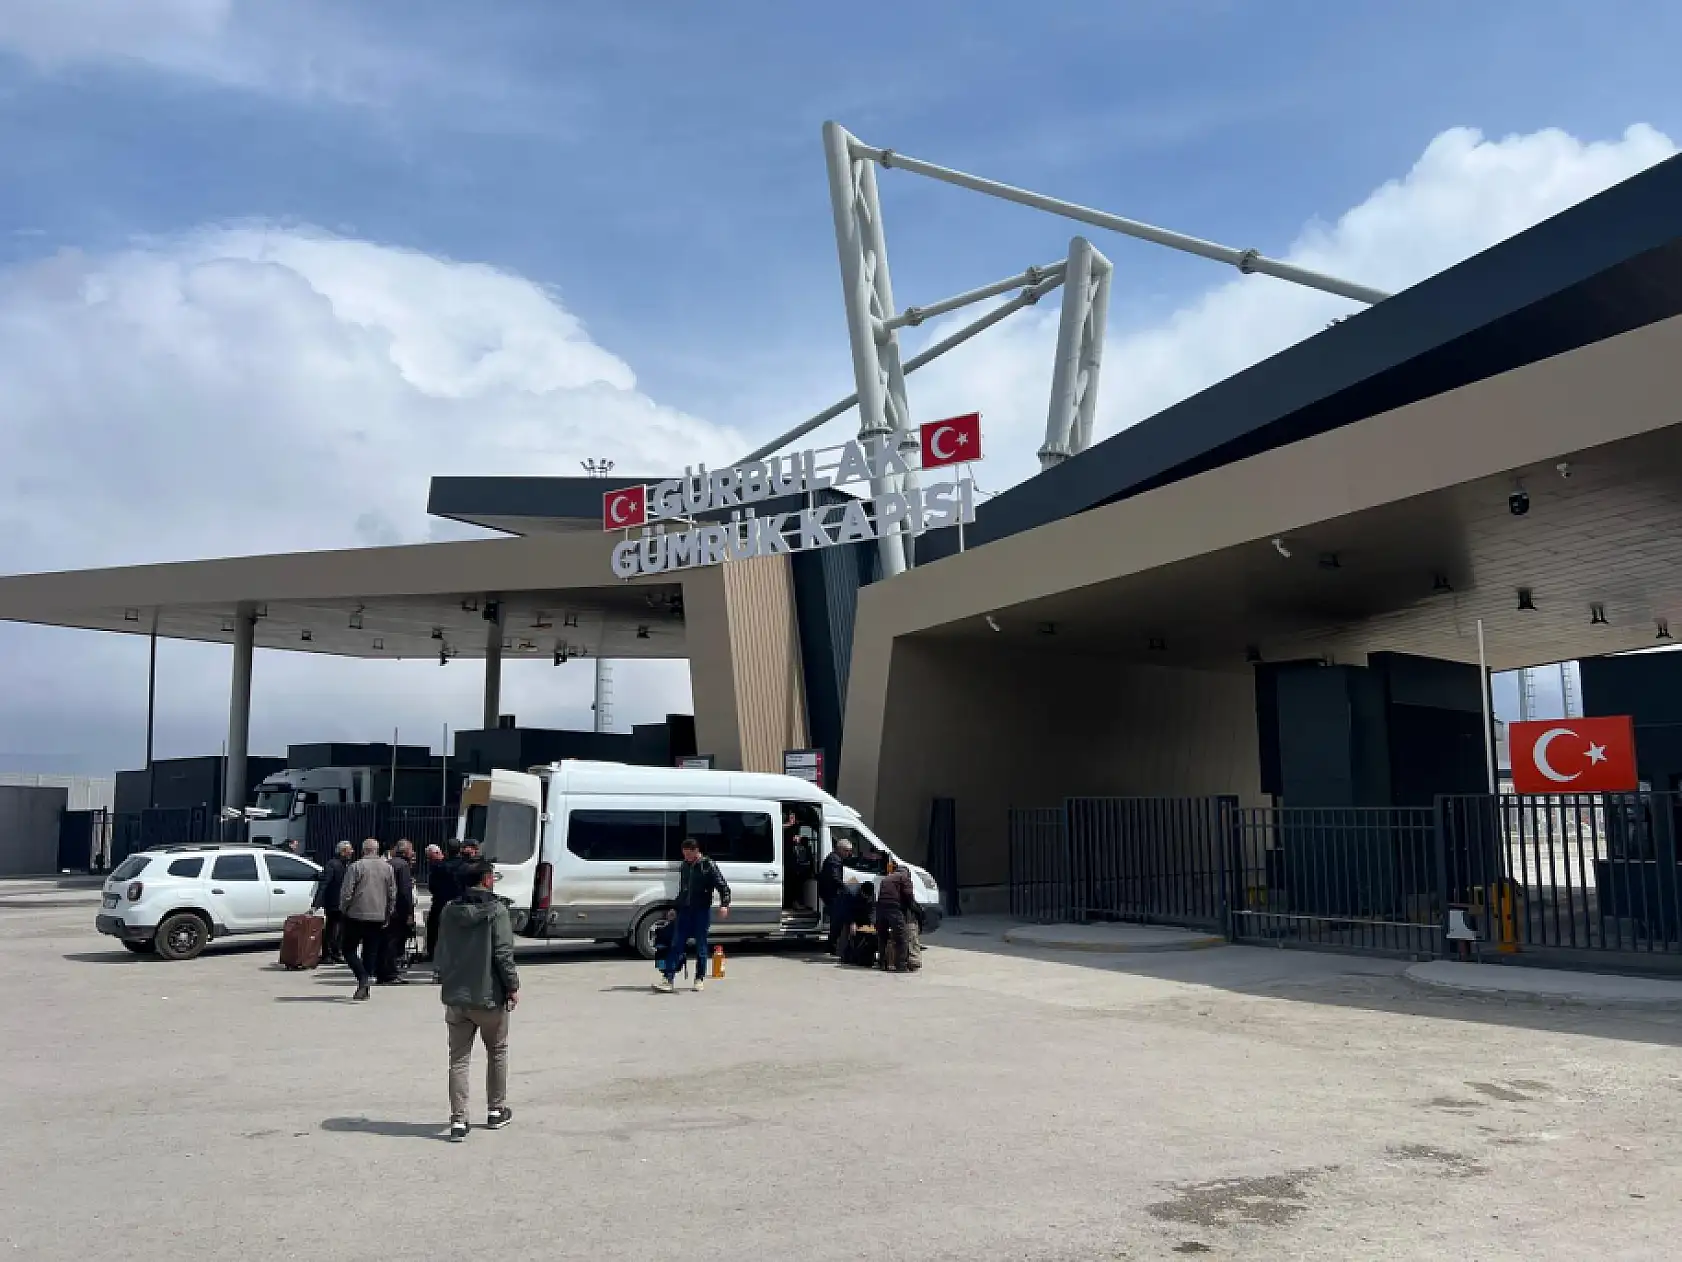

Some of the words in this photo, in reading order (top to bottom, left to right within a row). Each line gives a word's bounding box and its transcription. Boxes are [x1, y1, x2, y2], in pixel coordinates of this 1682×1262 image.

[653, 434, 908, 519] GÜRBULAK
[612, 508, 790, 579] GÜMRÜK
[801, 478, 976, 549] KAPISI
